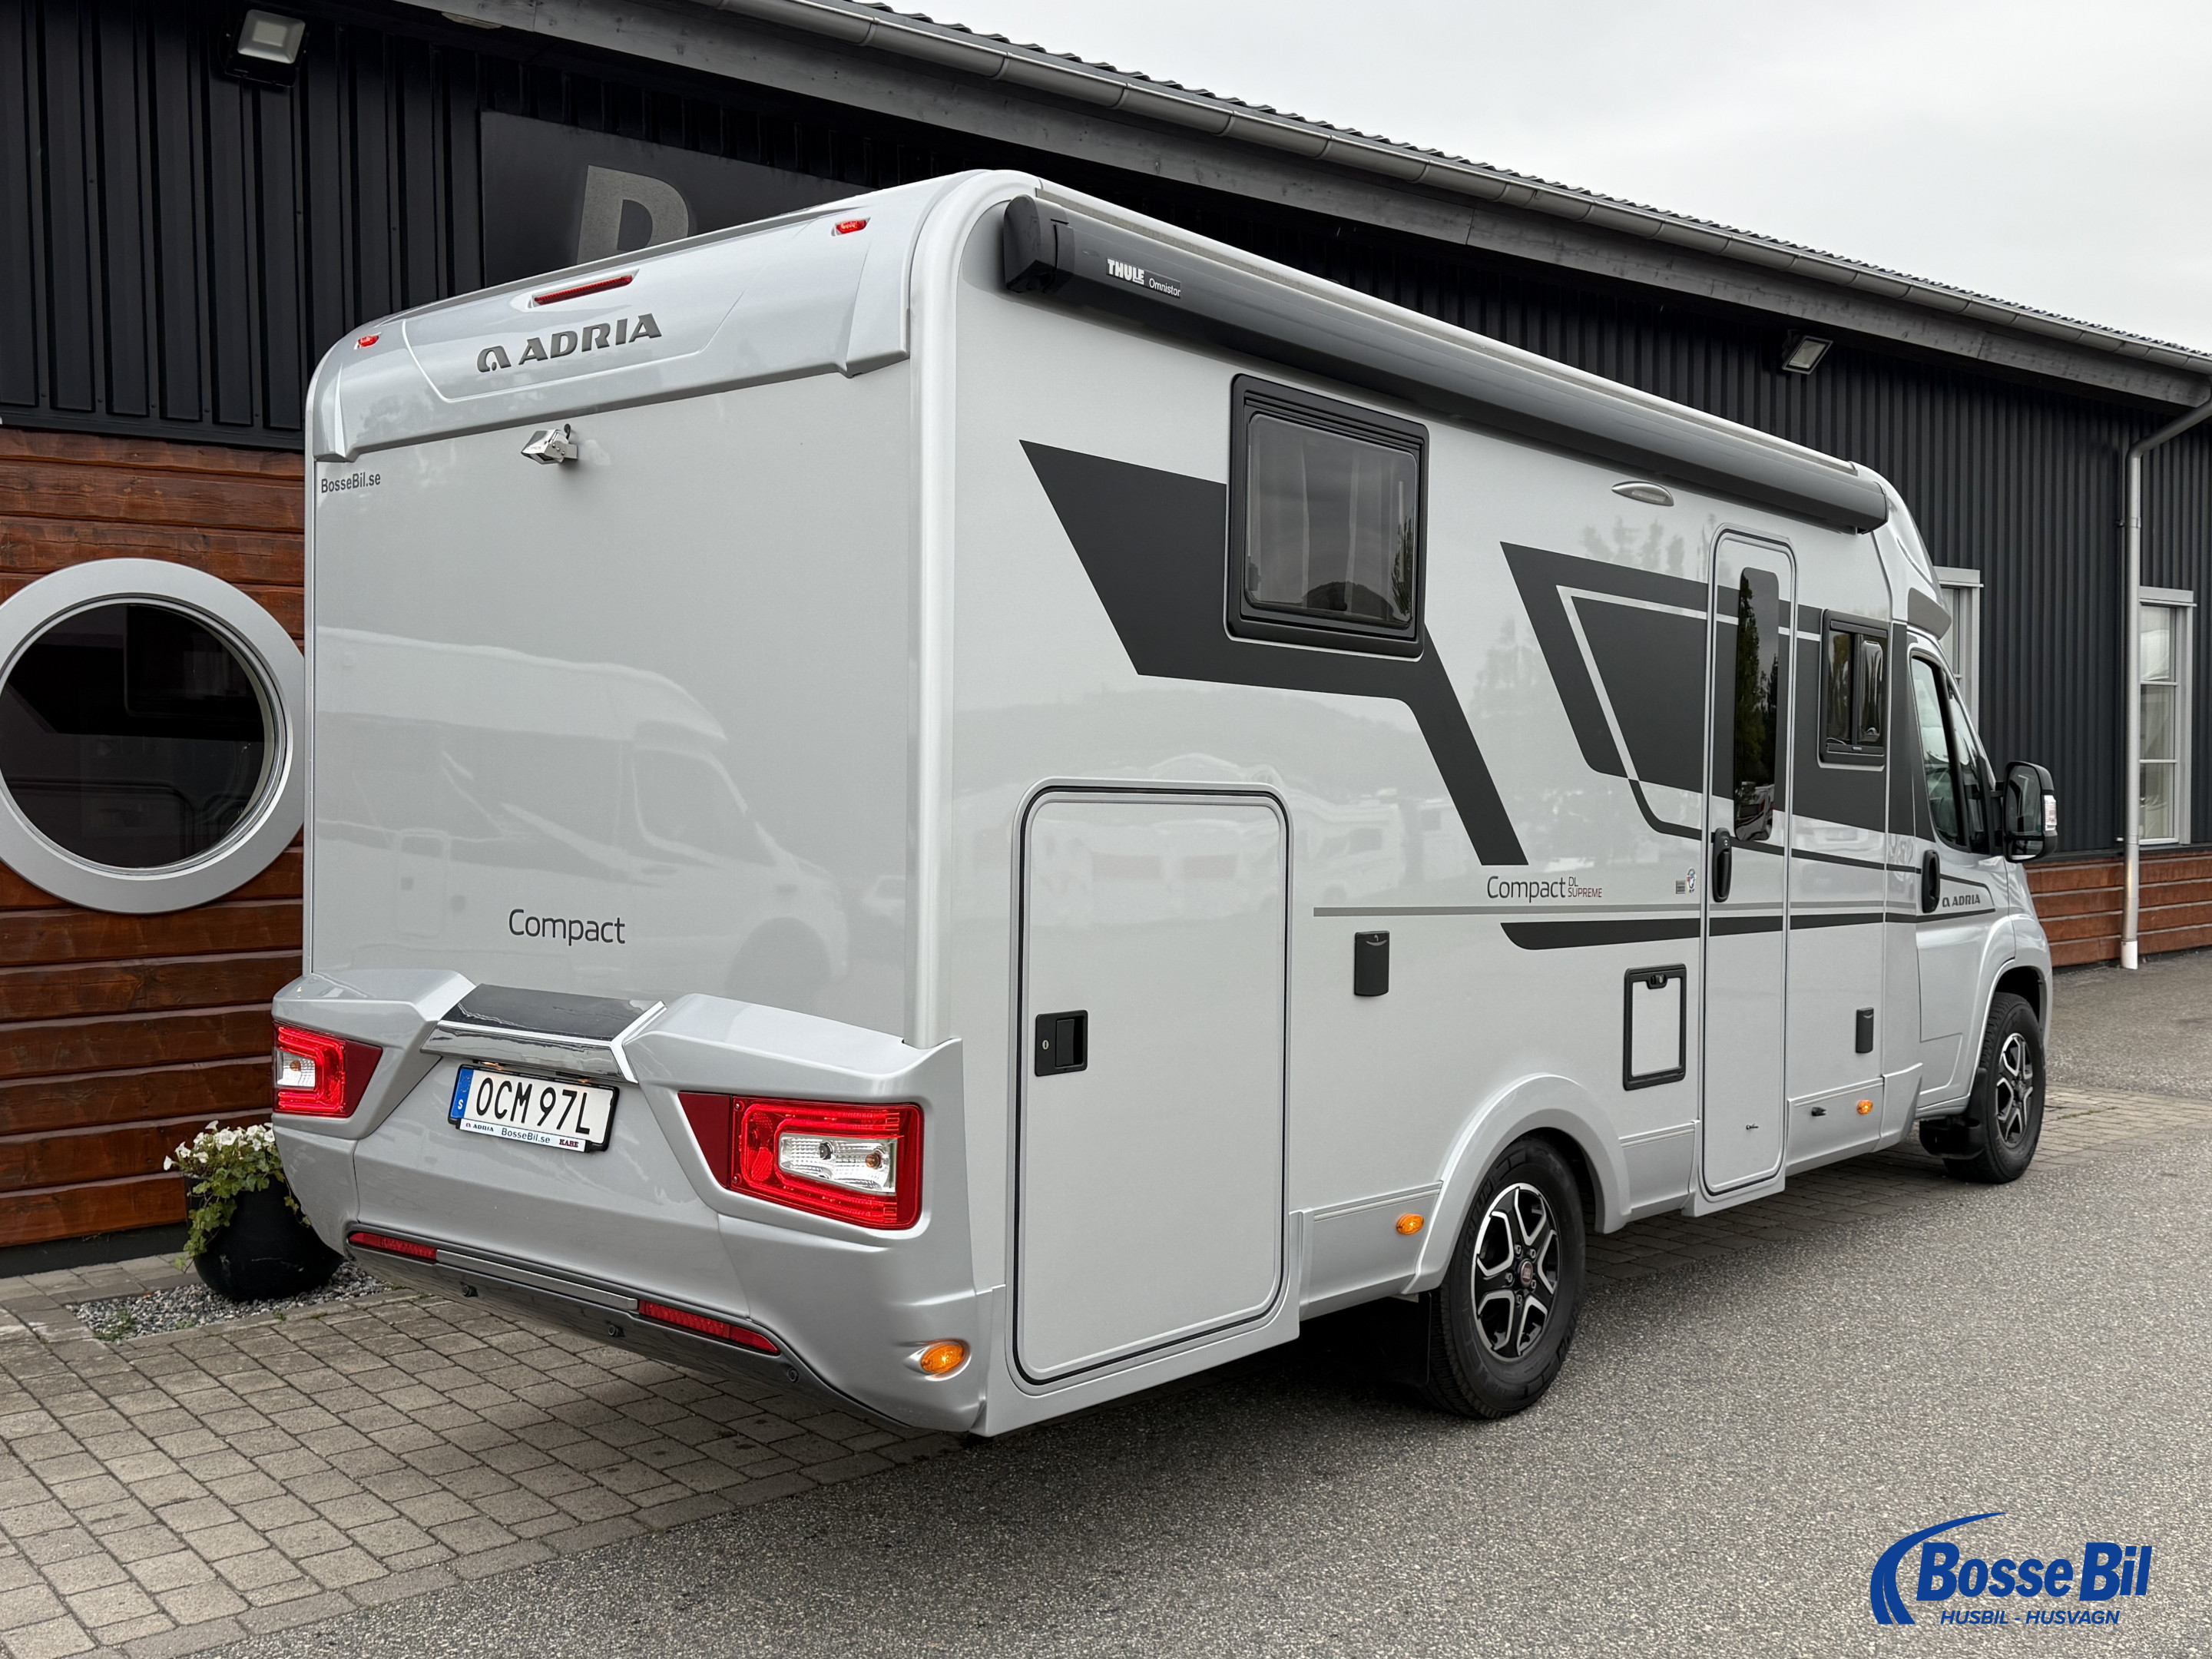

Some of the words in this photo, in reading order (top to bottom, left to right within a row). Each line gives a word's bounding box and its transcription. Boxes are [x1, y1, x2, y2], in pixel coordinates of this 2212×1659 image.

[1107, 258, 1144, 285] THULE
[1149, 278, 1181, 296] Omnistor
[519, 313, 661, 365] ADRIA
[321, 472, 381, 493] BosseBil.se
[1487, 876, 1565, 902] Compact
[1568, 876, 1578, 887] DL
[1568, 887, 1602, 898] SUPREME
[1952, 894, 1981, 906] ADRIA
[508, 909, 625, 946] Compact
[457, 1099, 464, 1110] S
[537, 1087, 591, 1135] 97L
[501, 1127, 551, 1144] BosseBil.se
